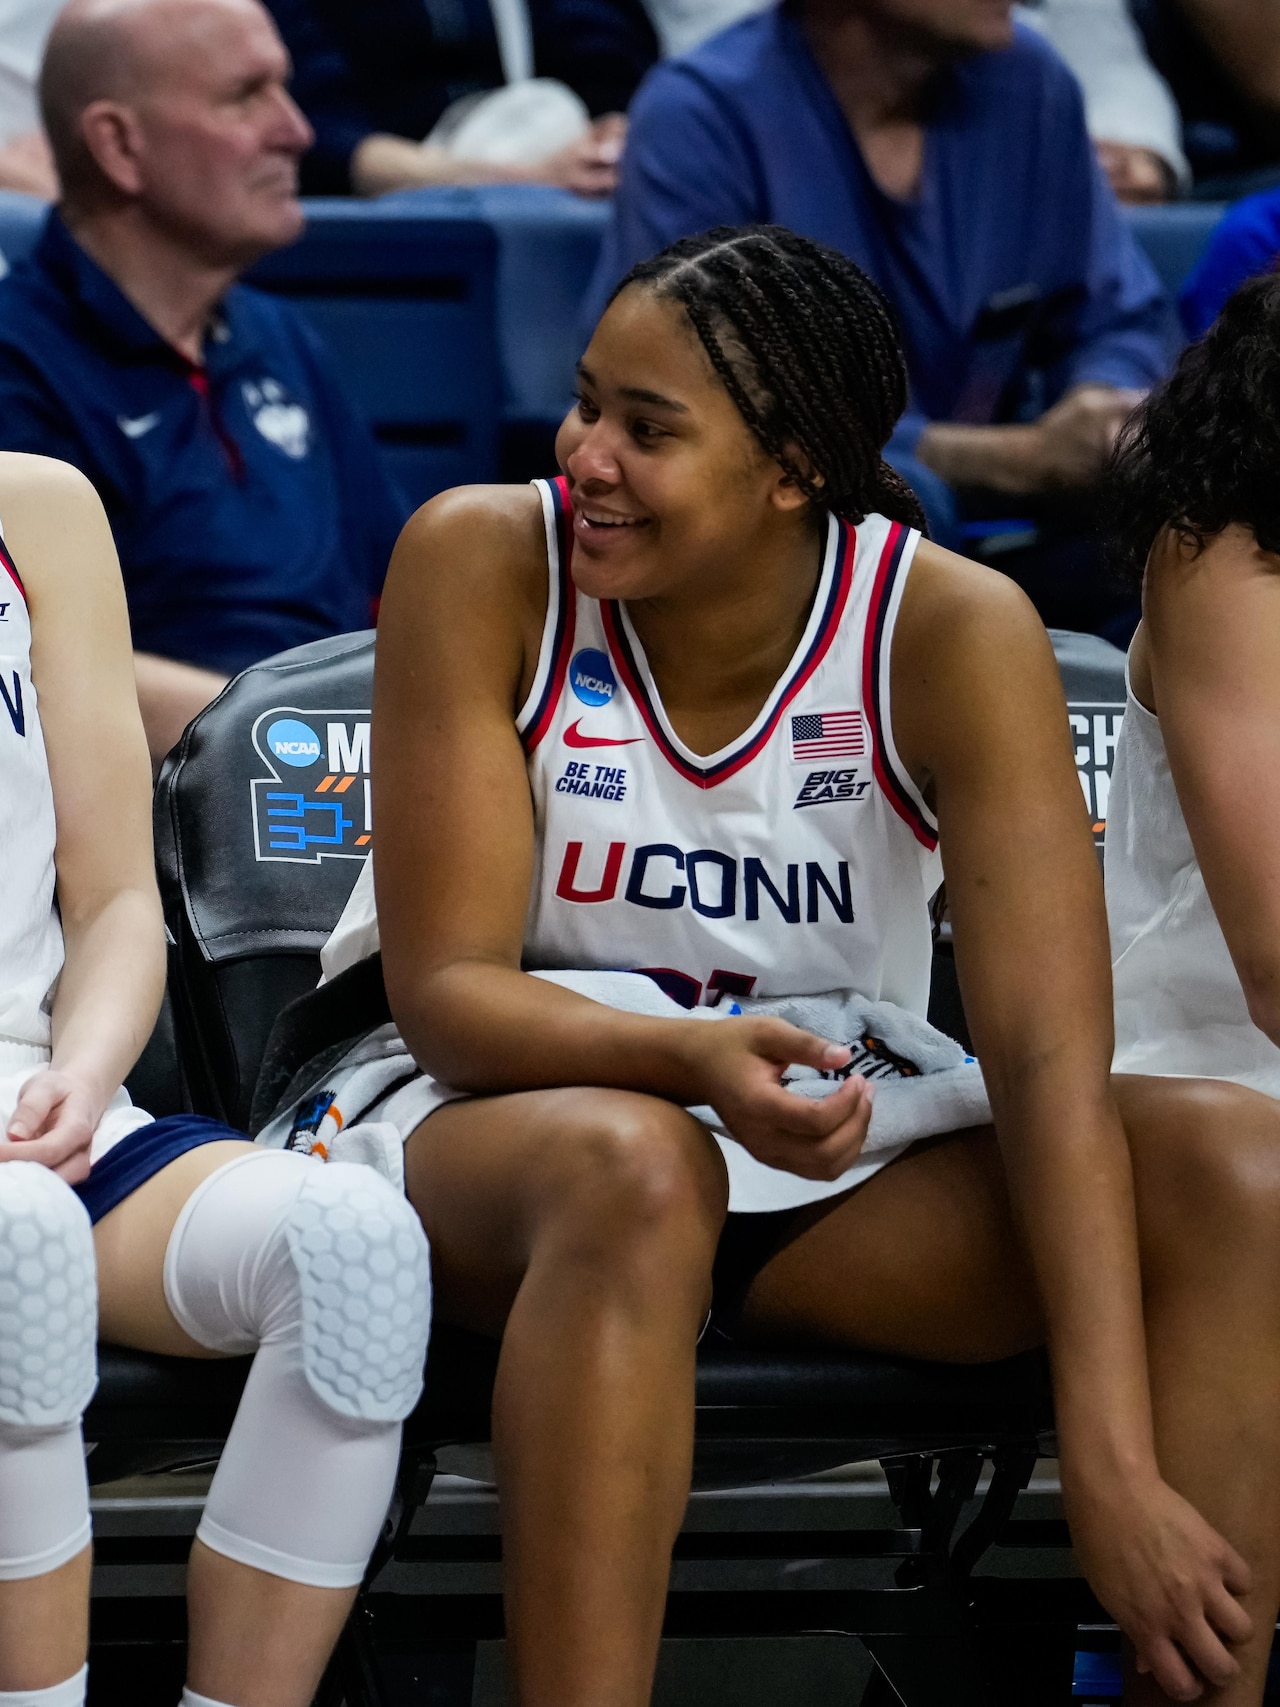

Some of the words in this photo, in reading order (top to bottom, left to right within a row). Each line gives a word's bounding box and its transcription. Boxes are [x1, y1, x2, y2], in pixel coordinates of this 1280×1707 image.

[574, 671, 614, 698] NCAA
[274, 741, 321, 756] NCAA
[564, 761, 589, 780] BE
[594, 766, 627, 784] THE
[803, 768, 858, 787] BIG
[554, 777, 627, 802] CHANGE
[797, 781, 870, 800] EAST
[555, 841, 855, 924] UCONN
